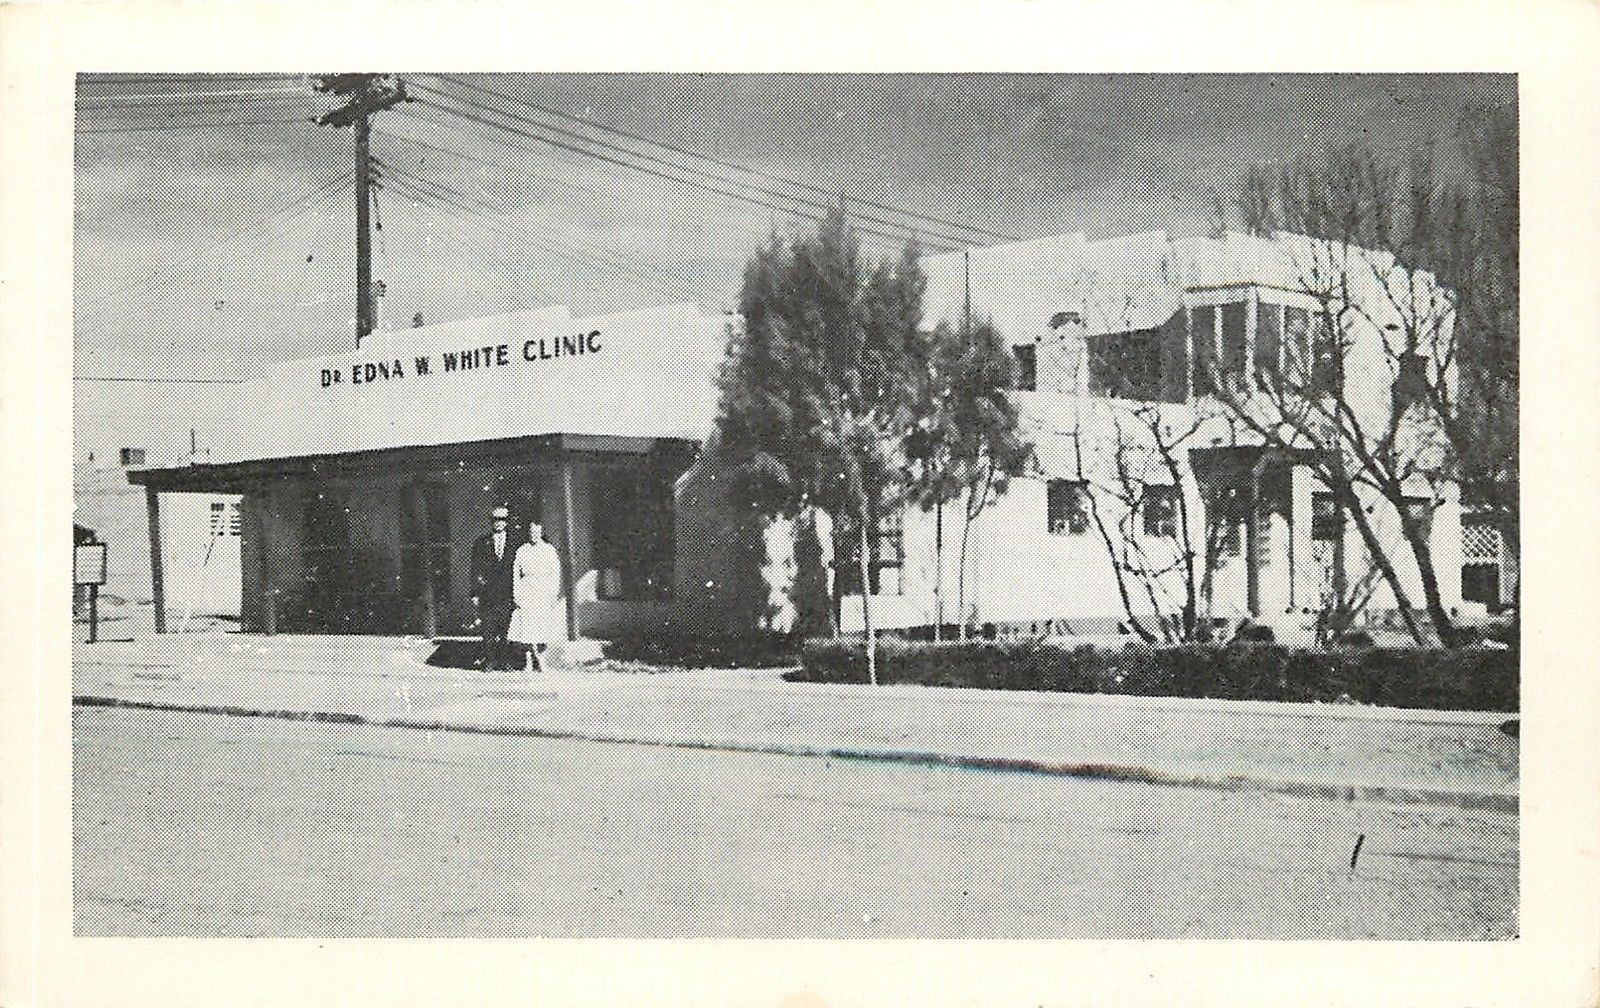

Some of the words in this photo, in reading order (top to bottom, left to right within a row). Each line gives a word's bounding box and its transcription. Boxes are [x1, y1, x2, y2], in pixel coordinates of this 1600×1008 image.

[352, 360, 404, 384] EDNA
[443, 344, 509, 372] WHITE
[523, 330, 602, 361] CLINIC
